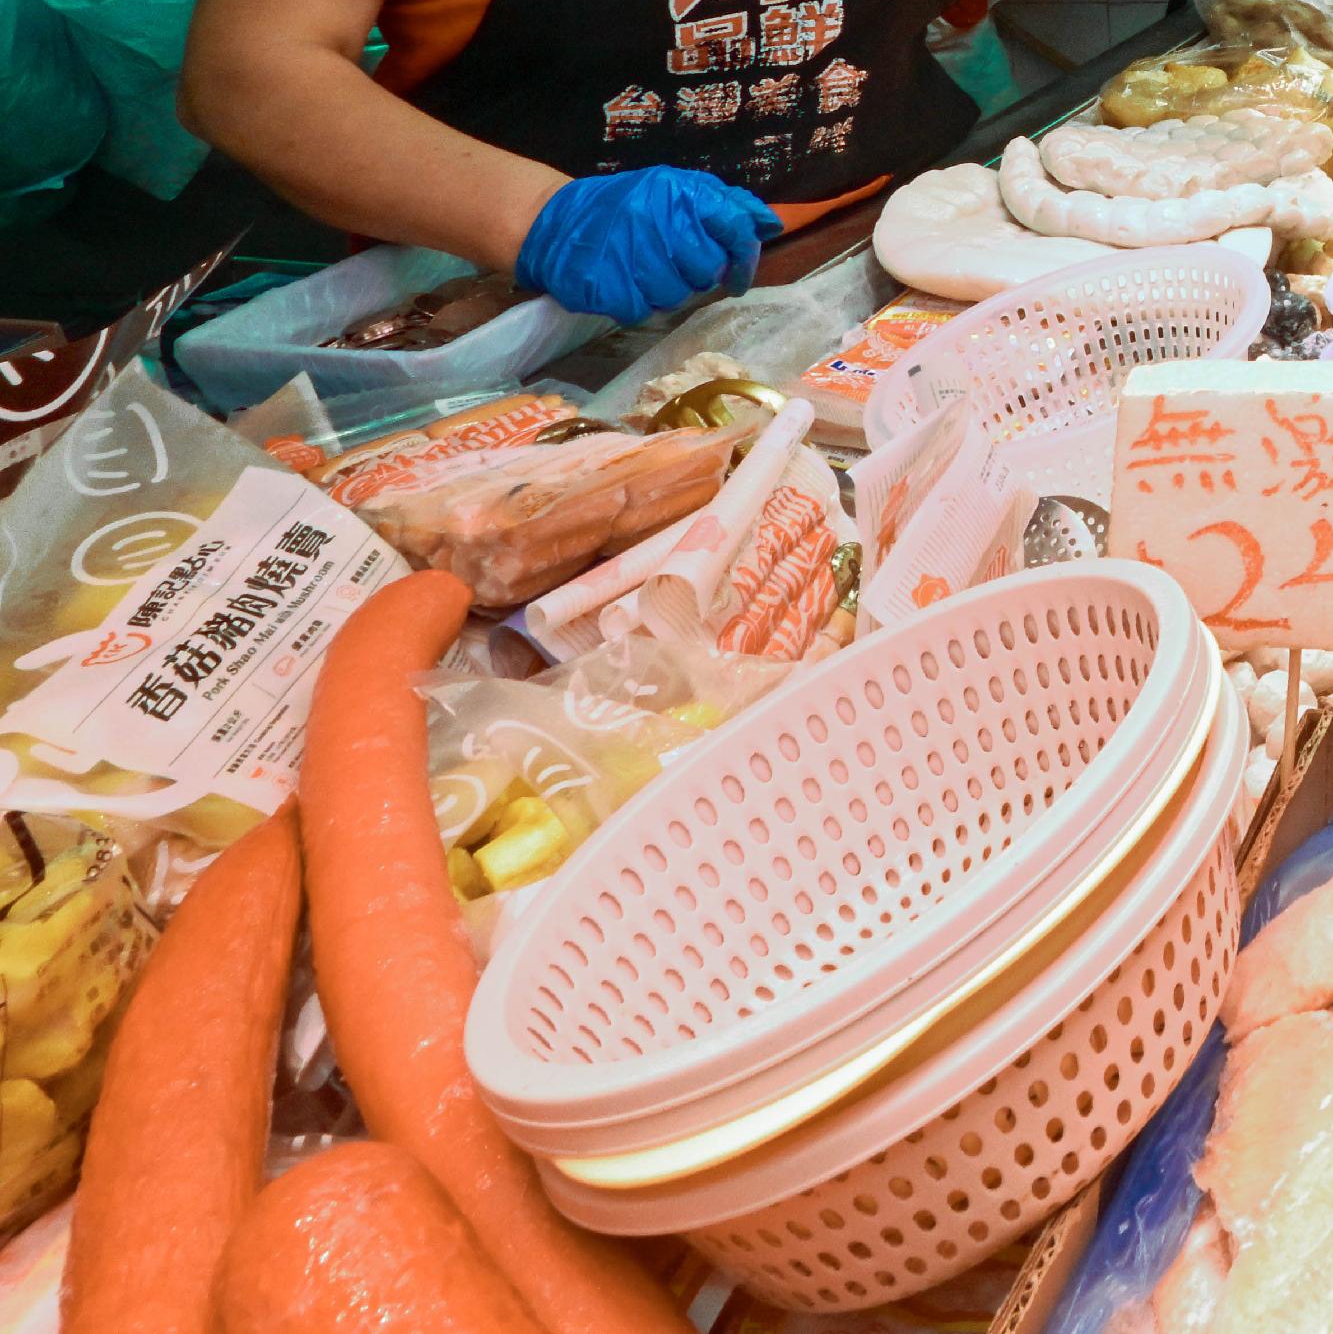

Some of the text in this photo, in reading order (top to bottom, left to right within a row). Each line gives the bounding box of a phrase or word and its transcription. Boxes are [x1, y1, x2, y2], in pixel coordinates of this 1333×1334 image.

[127, 538, 225, 630] 陳記點心
[127, 520, 336, 723] 香菇豬肉燒賣
[202, 676, 230, 701] Pork
[226, 646, 257, 676] Shao
[253, 623, 278, 646] Mai
[286, 559, 335, 609] Mushroom
